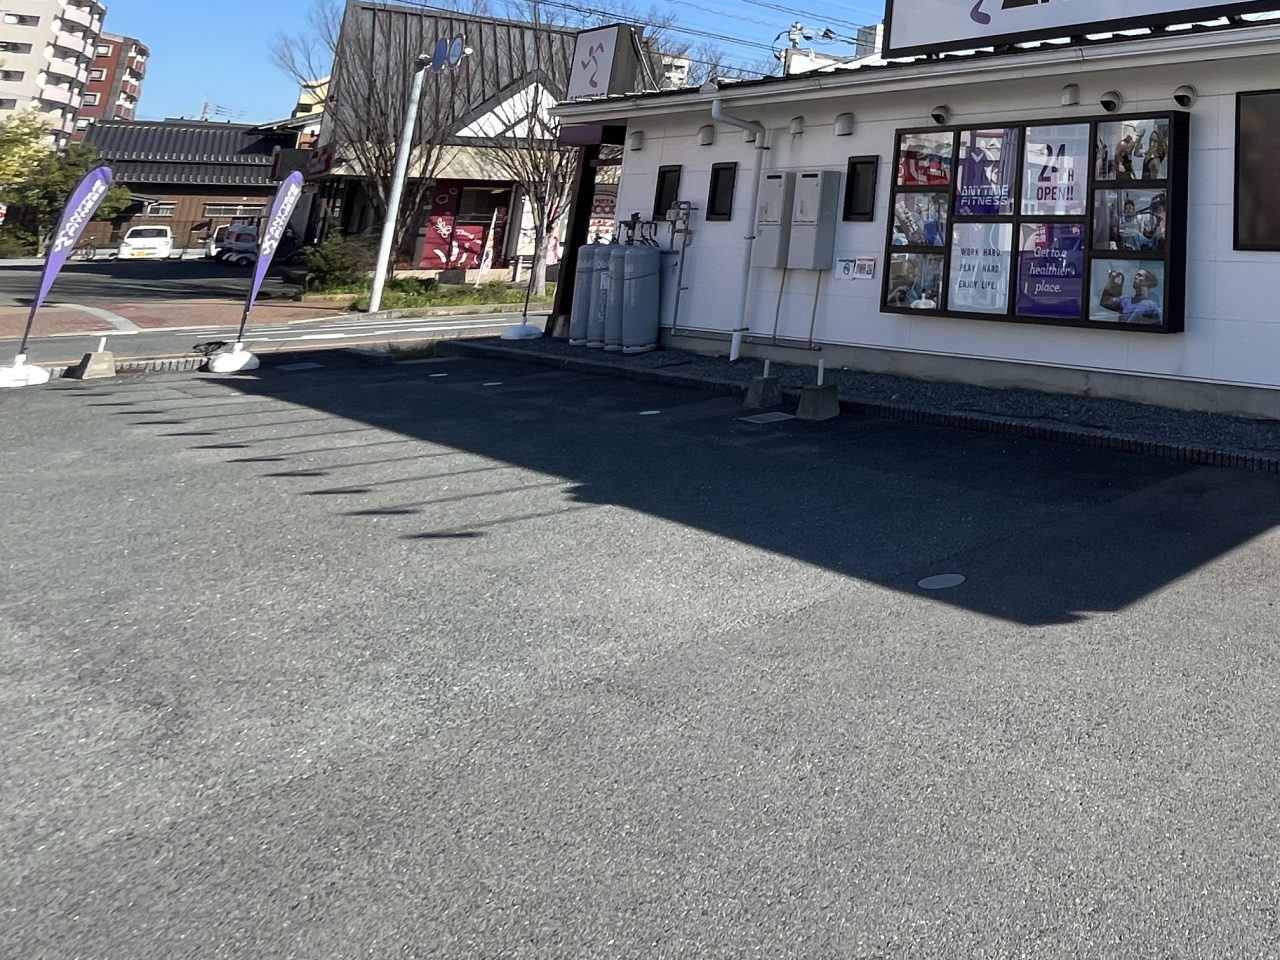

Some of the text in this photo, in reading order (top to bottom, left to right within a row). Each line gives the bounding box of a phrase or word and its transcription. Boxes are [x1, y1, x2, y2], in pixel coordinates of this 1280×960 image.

[961, 184, 1009, 196] ANYTIME
[1037, 186, 1074, 201] OPEN!!
[960, 196, 1008, 206] FITNESS
[961, 248, 979, 256] WORK
[1034, 247, 1049, 257] Get
[1030, 262, 1070, 276] healthier
[1034, 280, 1062, 294] place.
